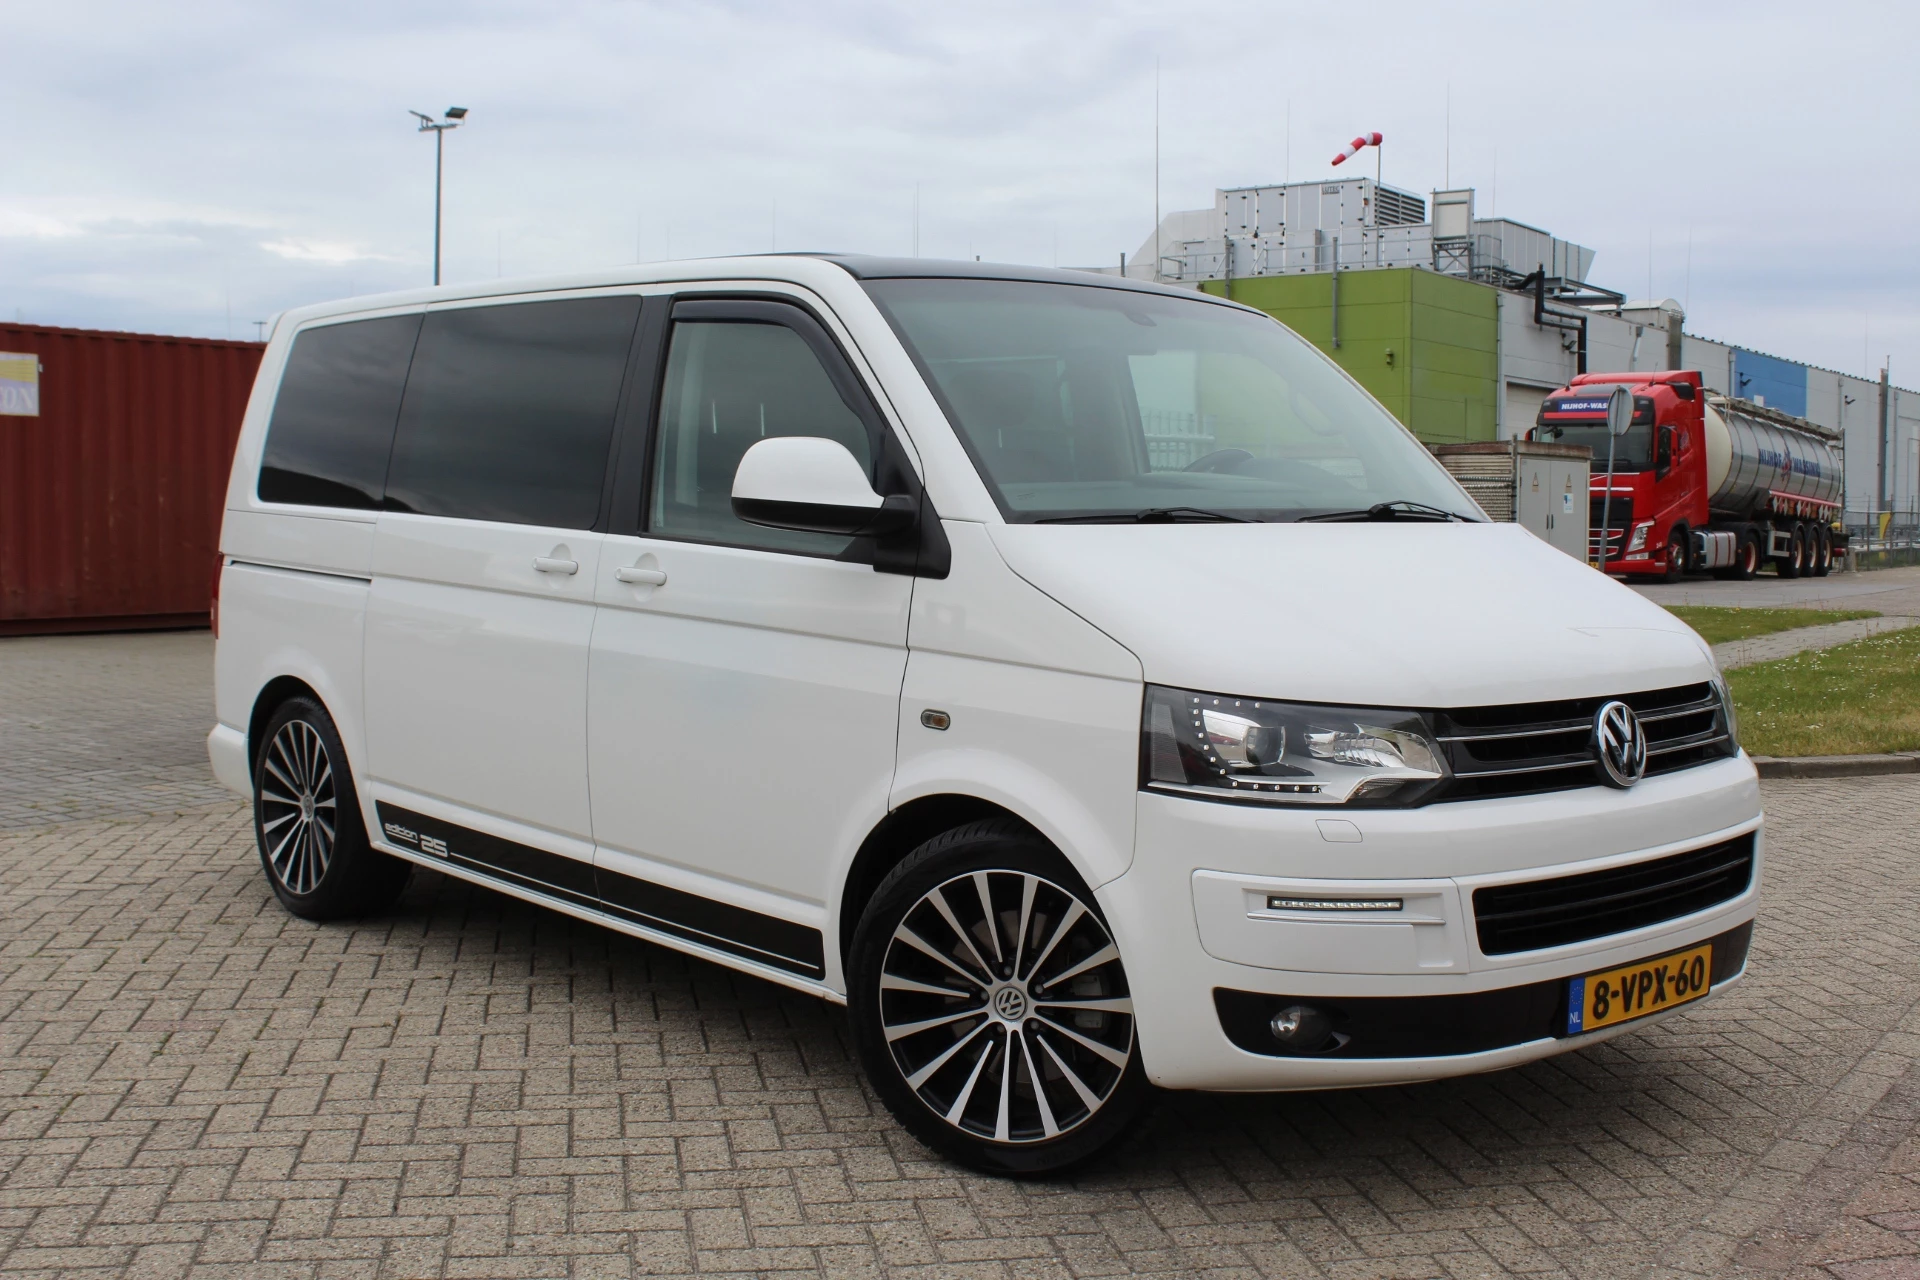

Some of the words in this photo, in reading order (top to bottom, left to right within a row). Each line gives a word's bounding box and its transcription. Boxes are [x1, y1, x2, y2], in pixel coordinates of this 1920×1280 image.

[1561, 402, 1608, 410] NIJHOF-WAS
[420, 834, 448, 857] 25
[1592, 954, 1705, 1020] 8-VPX-60
[1569, 1011, 1581, 1024] NL
